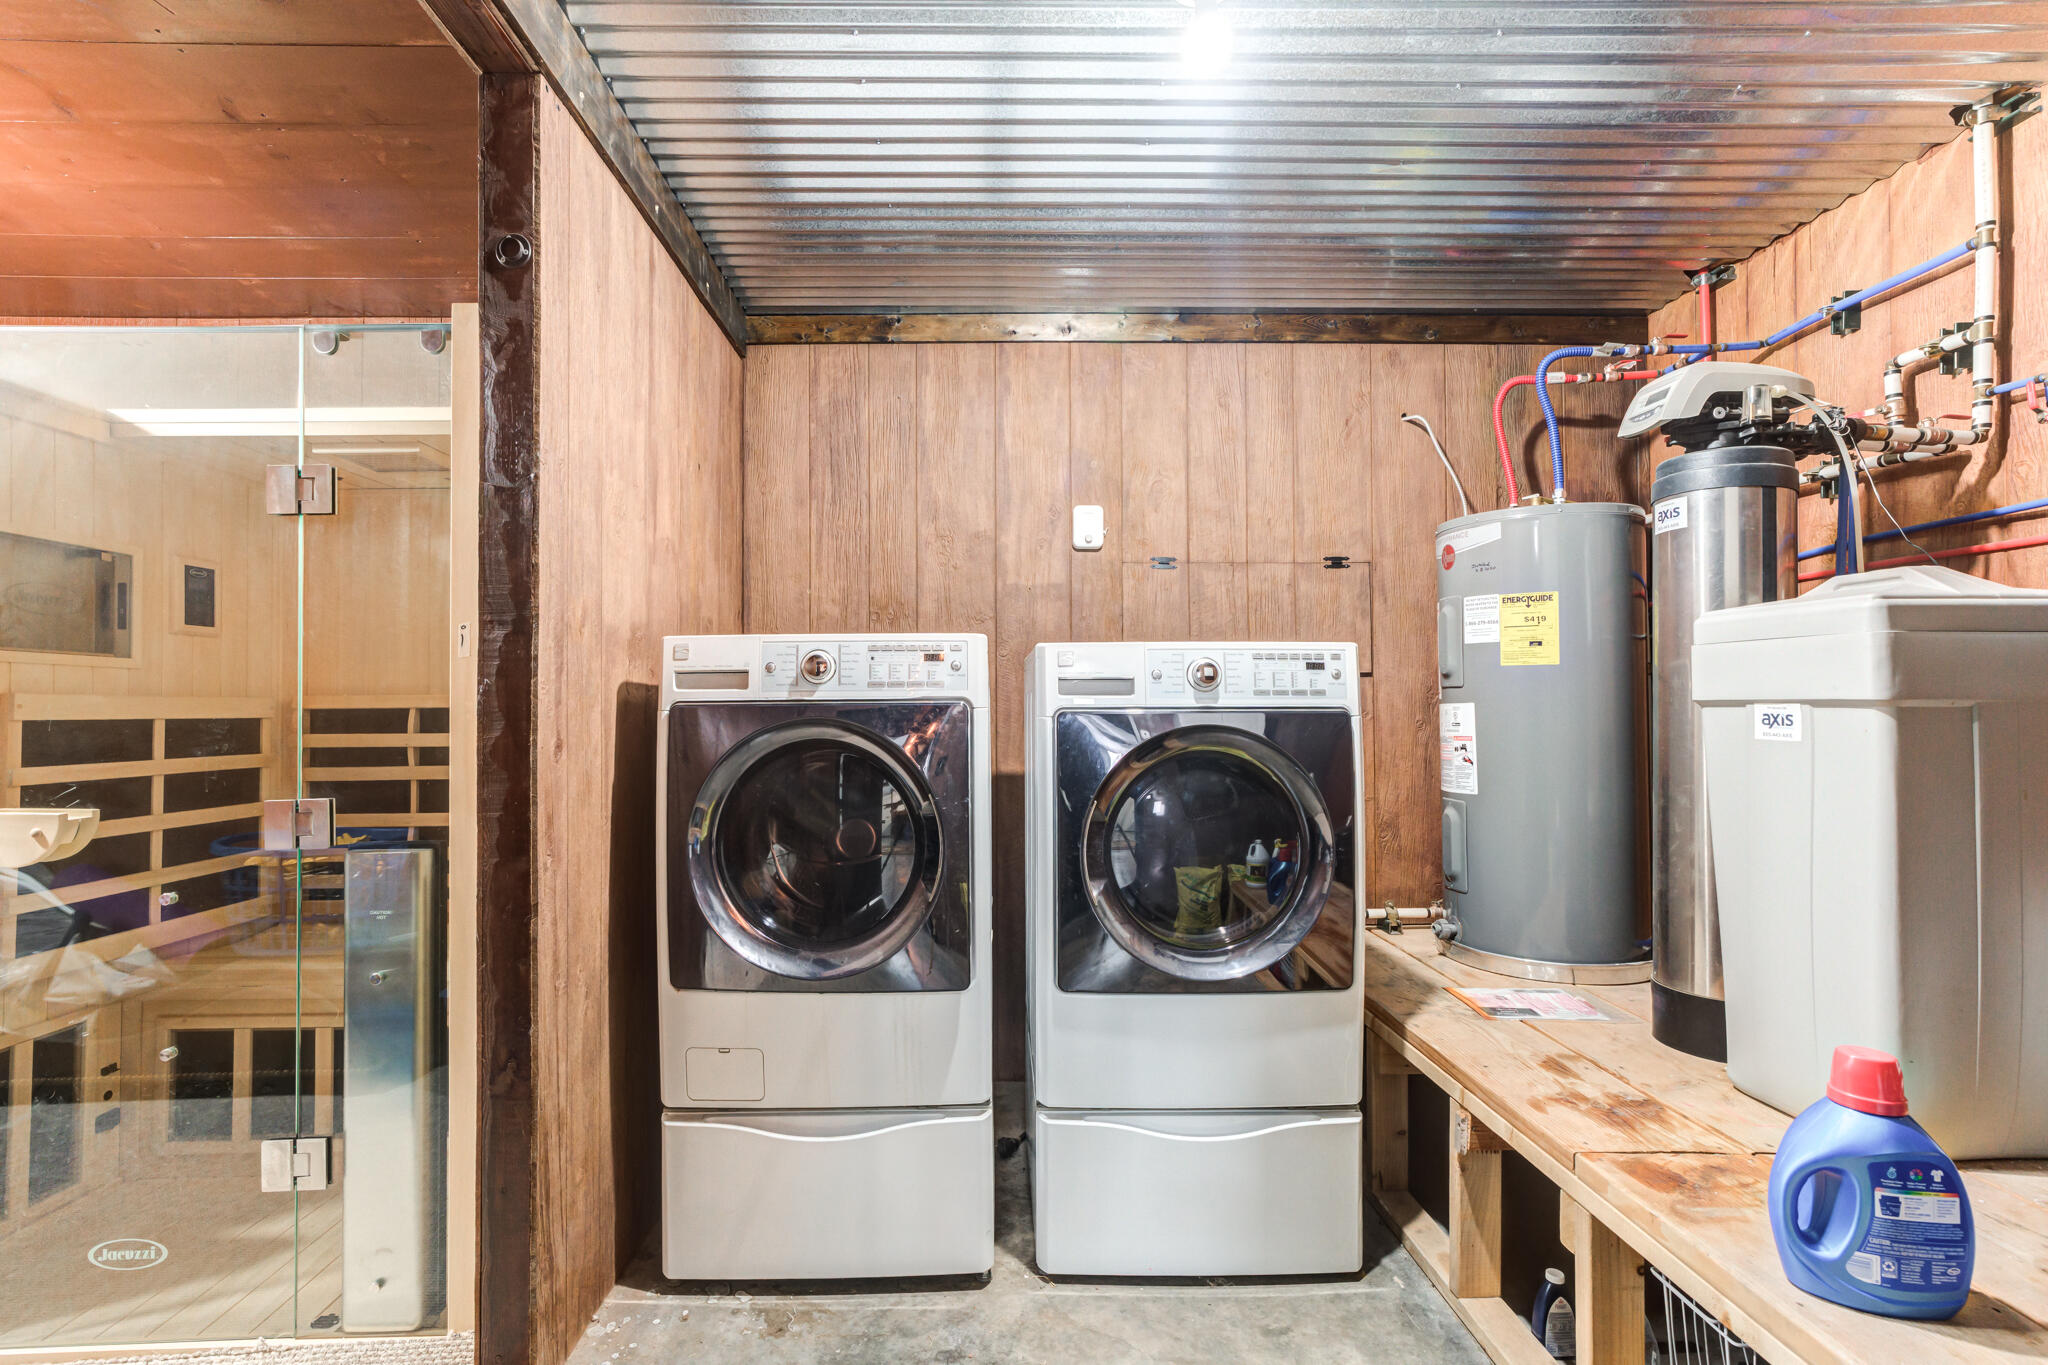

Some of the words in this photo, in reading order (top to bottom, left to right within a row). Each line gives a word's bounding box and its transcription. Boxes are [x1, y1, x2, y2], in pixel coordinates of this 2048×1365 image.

[1657, 507, 1680, 523] axis
[1502, 595, 1554, 606] ENERGYGUIDE
[1761, 713, 1794, 729] axis
[98, 1246, 156, 1261] Jacuzzi
